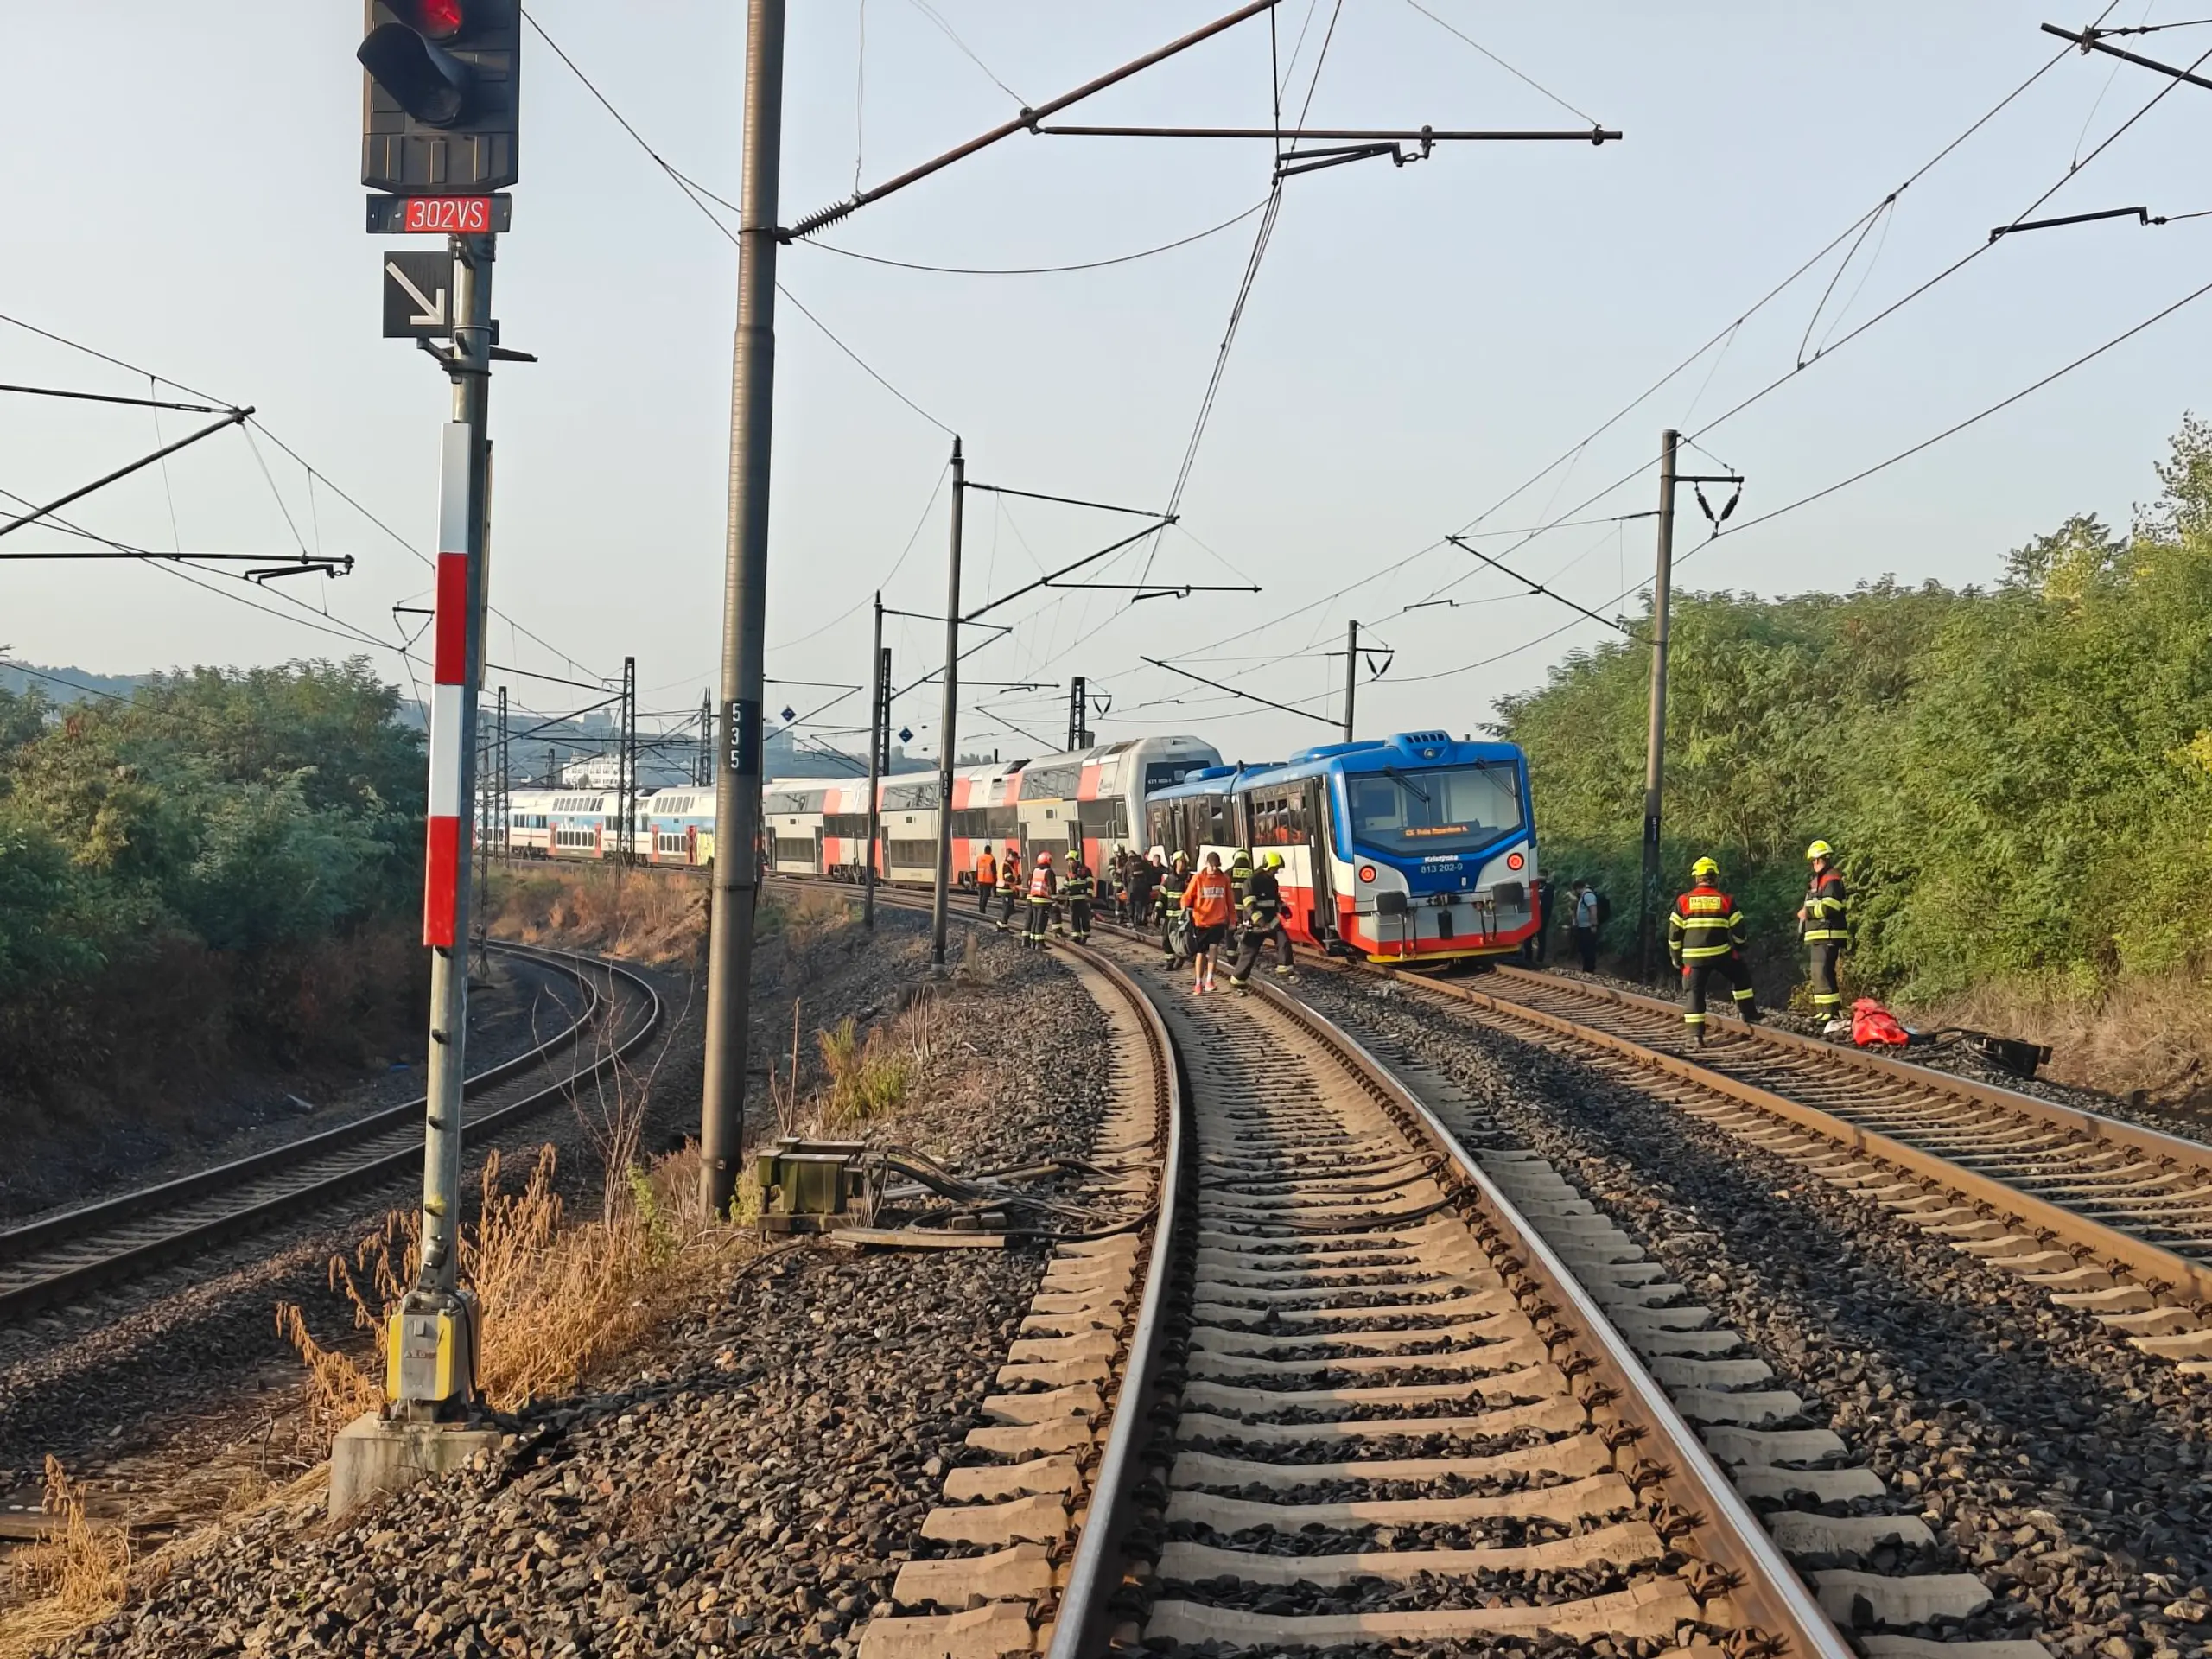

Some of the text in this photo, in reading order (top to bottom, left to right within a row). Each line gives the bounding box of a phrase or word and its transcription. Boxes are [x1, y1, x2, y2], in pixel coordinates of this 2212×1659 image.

[411, 200, 484, 228] 302VS
[730, 702, 741, 769] 535
[1439, 863, 1464, 872] 202-9
